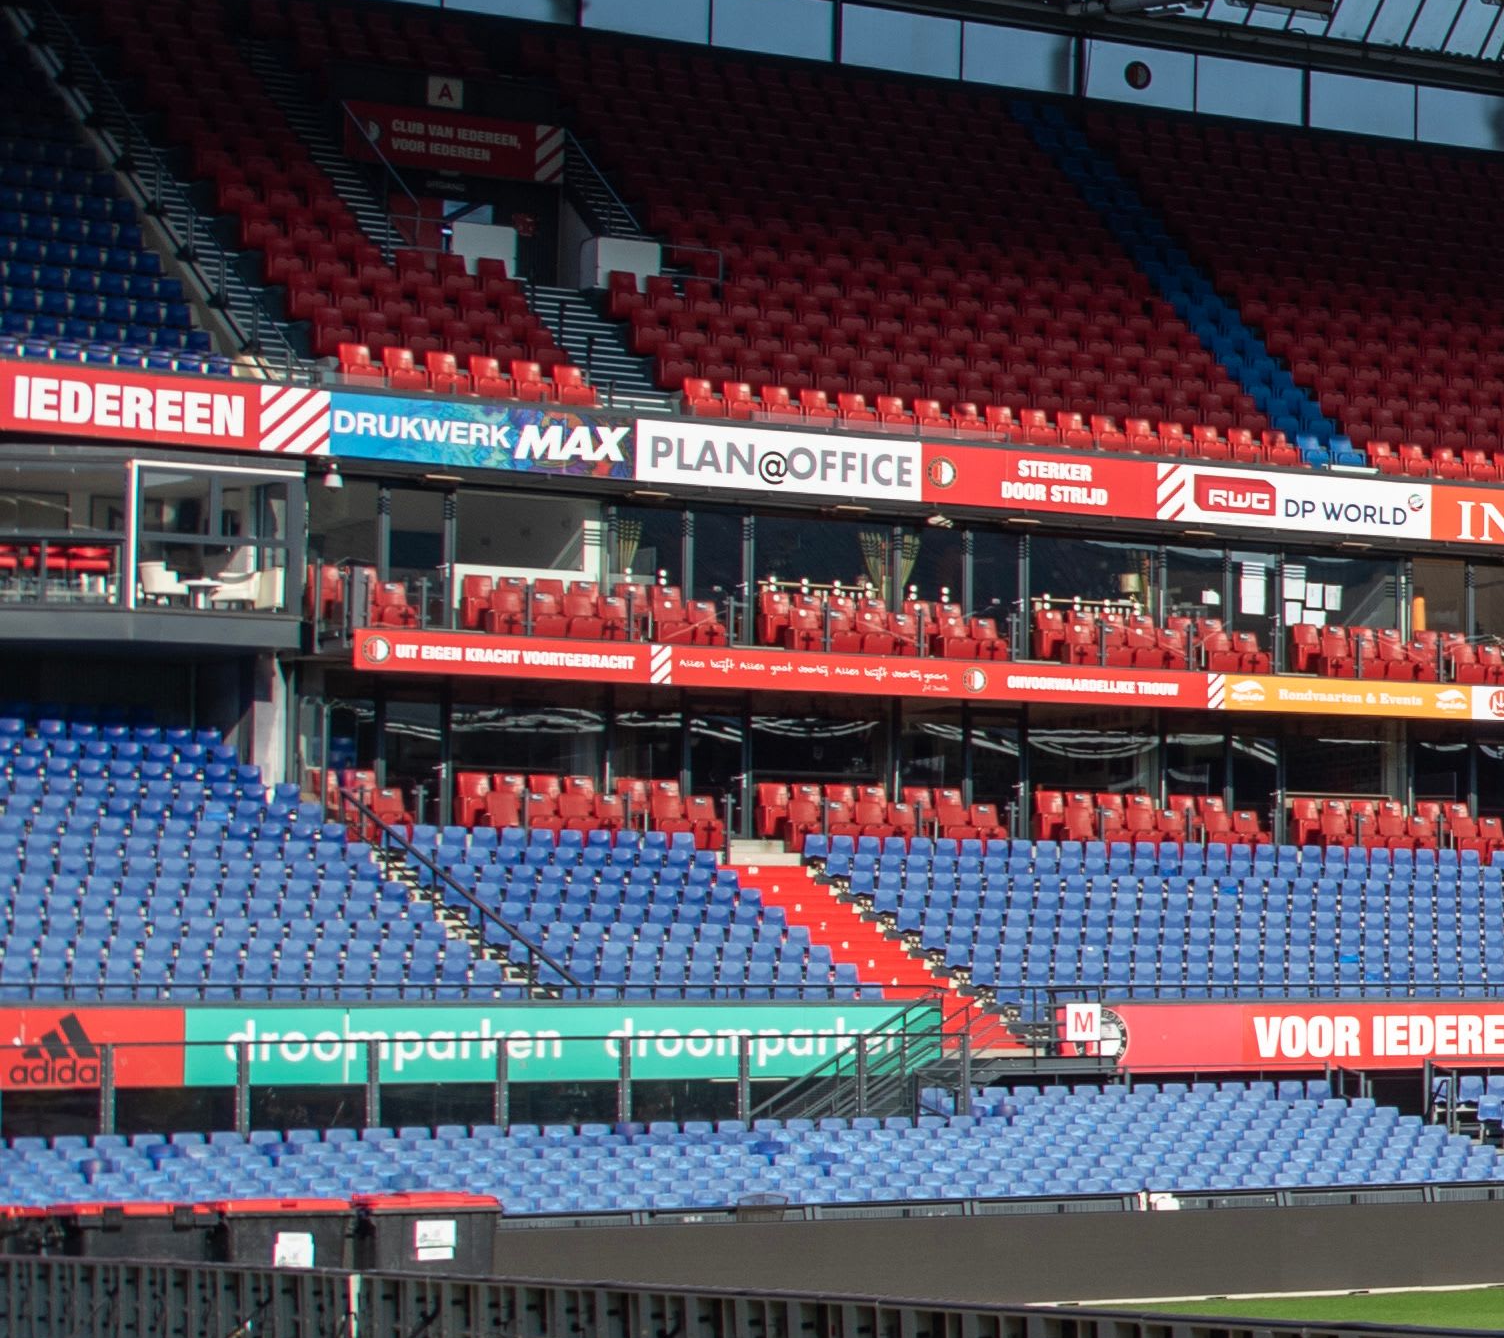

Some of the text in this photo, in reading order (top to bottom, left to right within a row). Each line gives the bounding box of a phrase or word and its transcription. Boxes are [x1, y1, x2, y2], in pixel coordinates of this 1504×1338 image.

[437, 83, 455, 102] A
[391, 119, 522, 150] CLUB VAN IEDEREEN,
[391, 137, 491, 162] VOOR IEDEREEN
[14, 375, 245, 438] IEDEREEN
[334, 410, 631, 461] DRUKWERK MAX
[651, 436, 913, 487] PLAN@OFFICE
[1017, 459, 1092, 482] STERKER
[1001, 481, 1108, 507] DOOR STRIJD
[1208, 488, 1270, 510] RWG
[1285, 499, 1407, 526] DP WORLD
[396, 643, 636, 670] UIT EIGEN KRACHT VOORTGEBRACHT
[1279, 688, 1424, 707] Rondvaarten & Events
[1074, 1011, 1094, 1033] M
[226, 1018, 563, 1072] droomparken
[1253, 1014, 1361, 1058] VOOR
